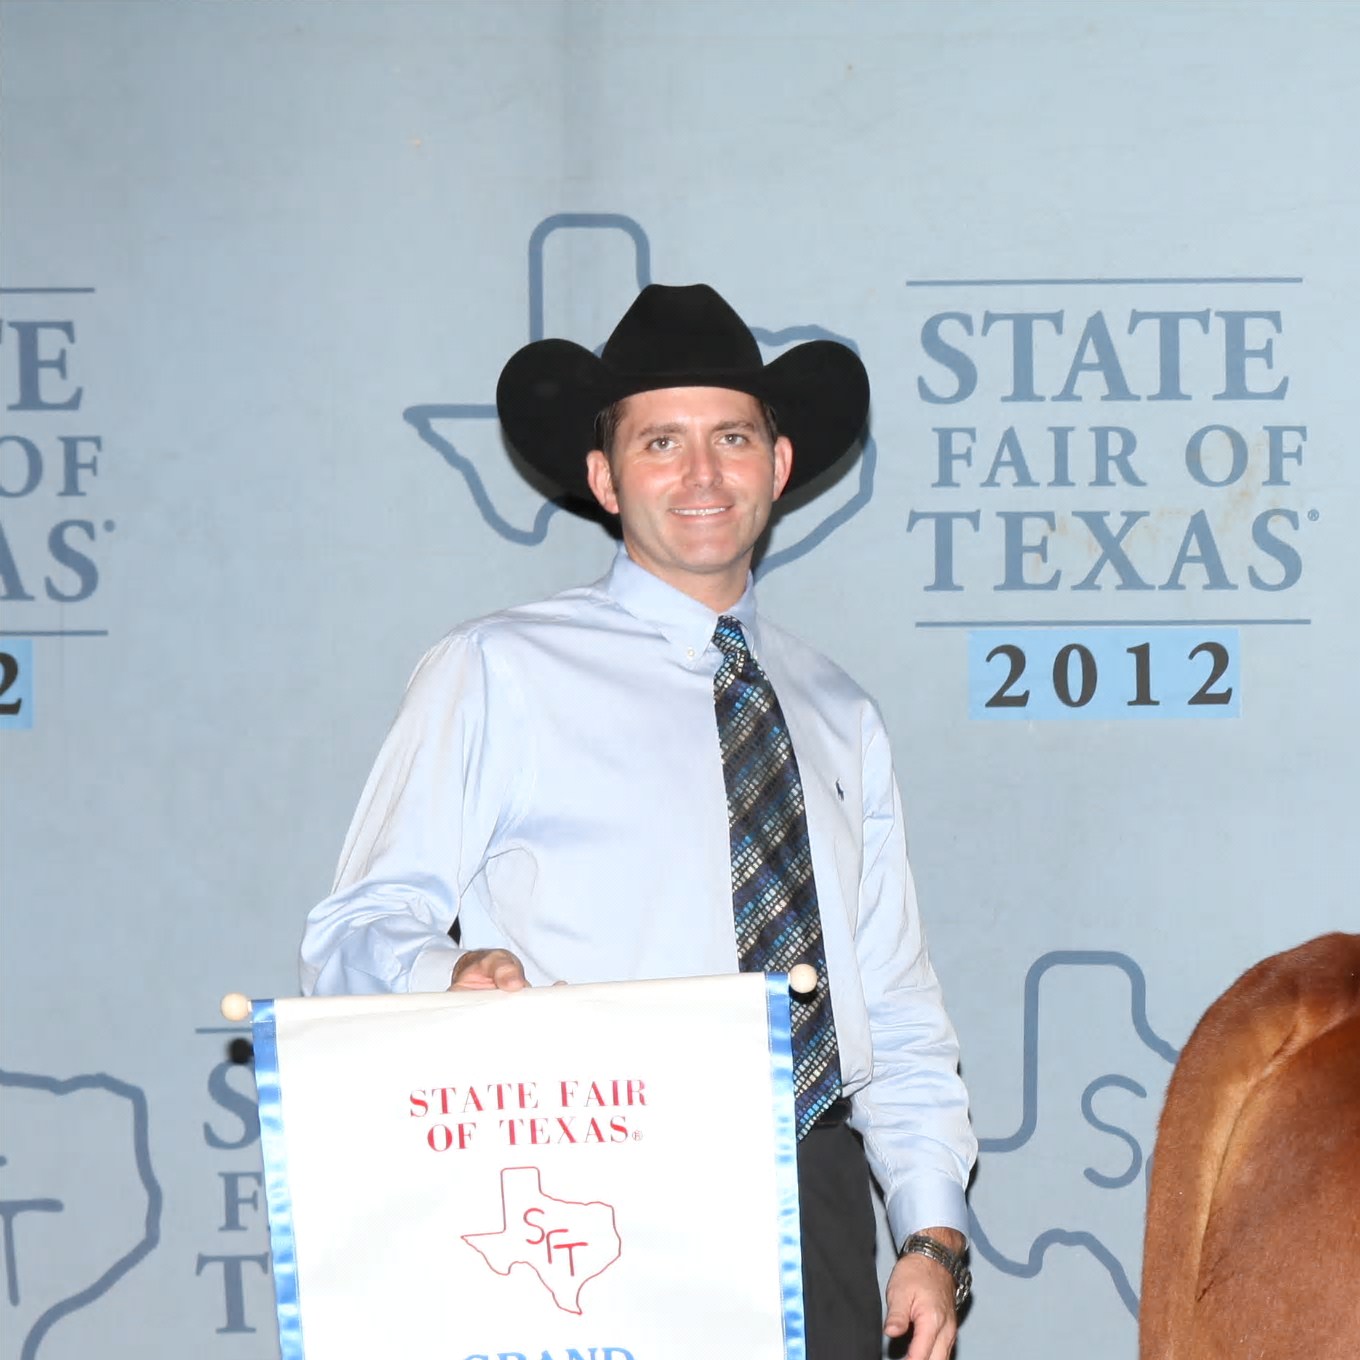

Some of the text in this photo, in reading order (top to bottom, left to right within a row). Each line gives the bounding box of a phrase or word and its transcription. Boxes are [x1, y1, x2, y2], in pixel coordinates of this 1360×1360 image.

[917, 308, 1290, 405] STATE
[931, 424, 1307, 488] FAIR OF
[984, 641, 1234, 708] 2012
[409, 1078, 649, 1118] STATE FAIR
[427, 1121, 477, 1153] OF
